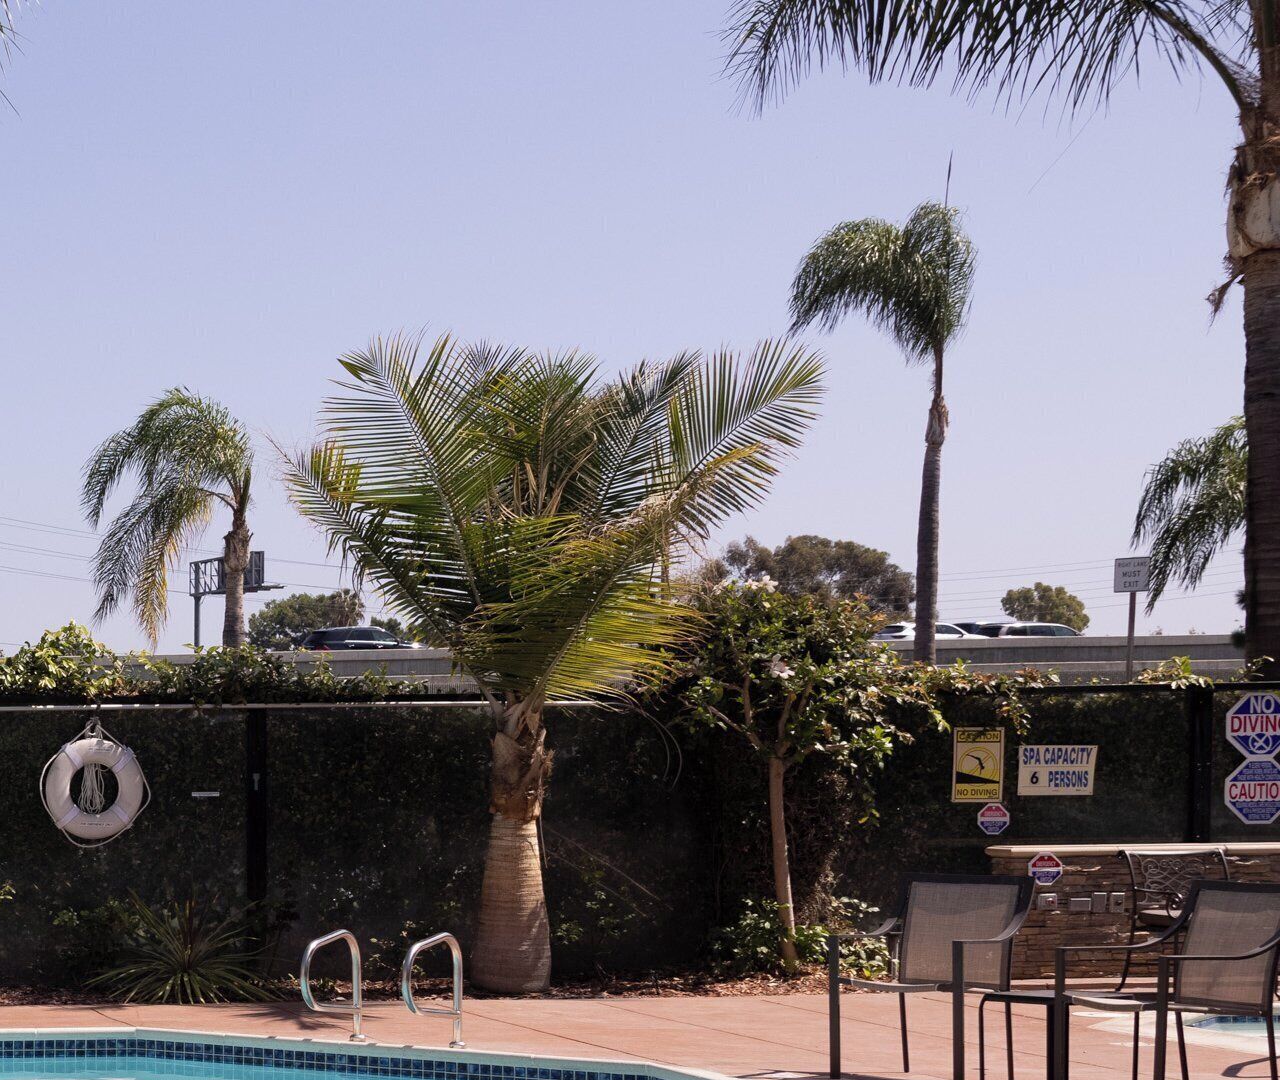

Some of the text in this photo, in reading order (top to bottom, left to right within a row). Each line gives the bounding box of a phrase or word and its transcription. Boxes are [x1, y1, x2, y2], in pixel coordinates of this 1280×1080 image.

[1250, 696, 1275, 714] NO
[1023, 748, 1092, 765] SPA CAPACITY
[1030, 771, 1089, 787] 6 PERSONS
[970, 788, 997, 796] DIVING
[1229, 783, 1279, 800] CAUTIO
